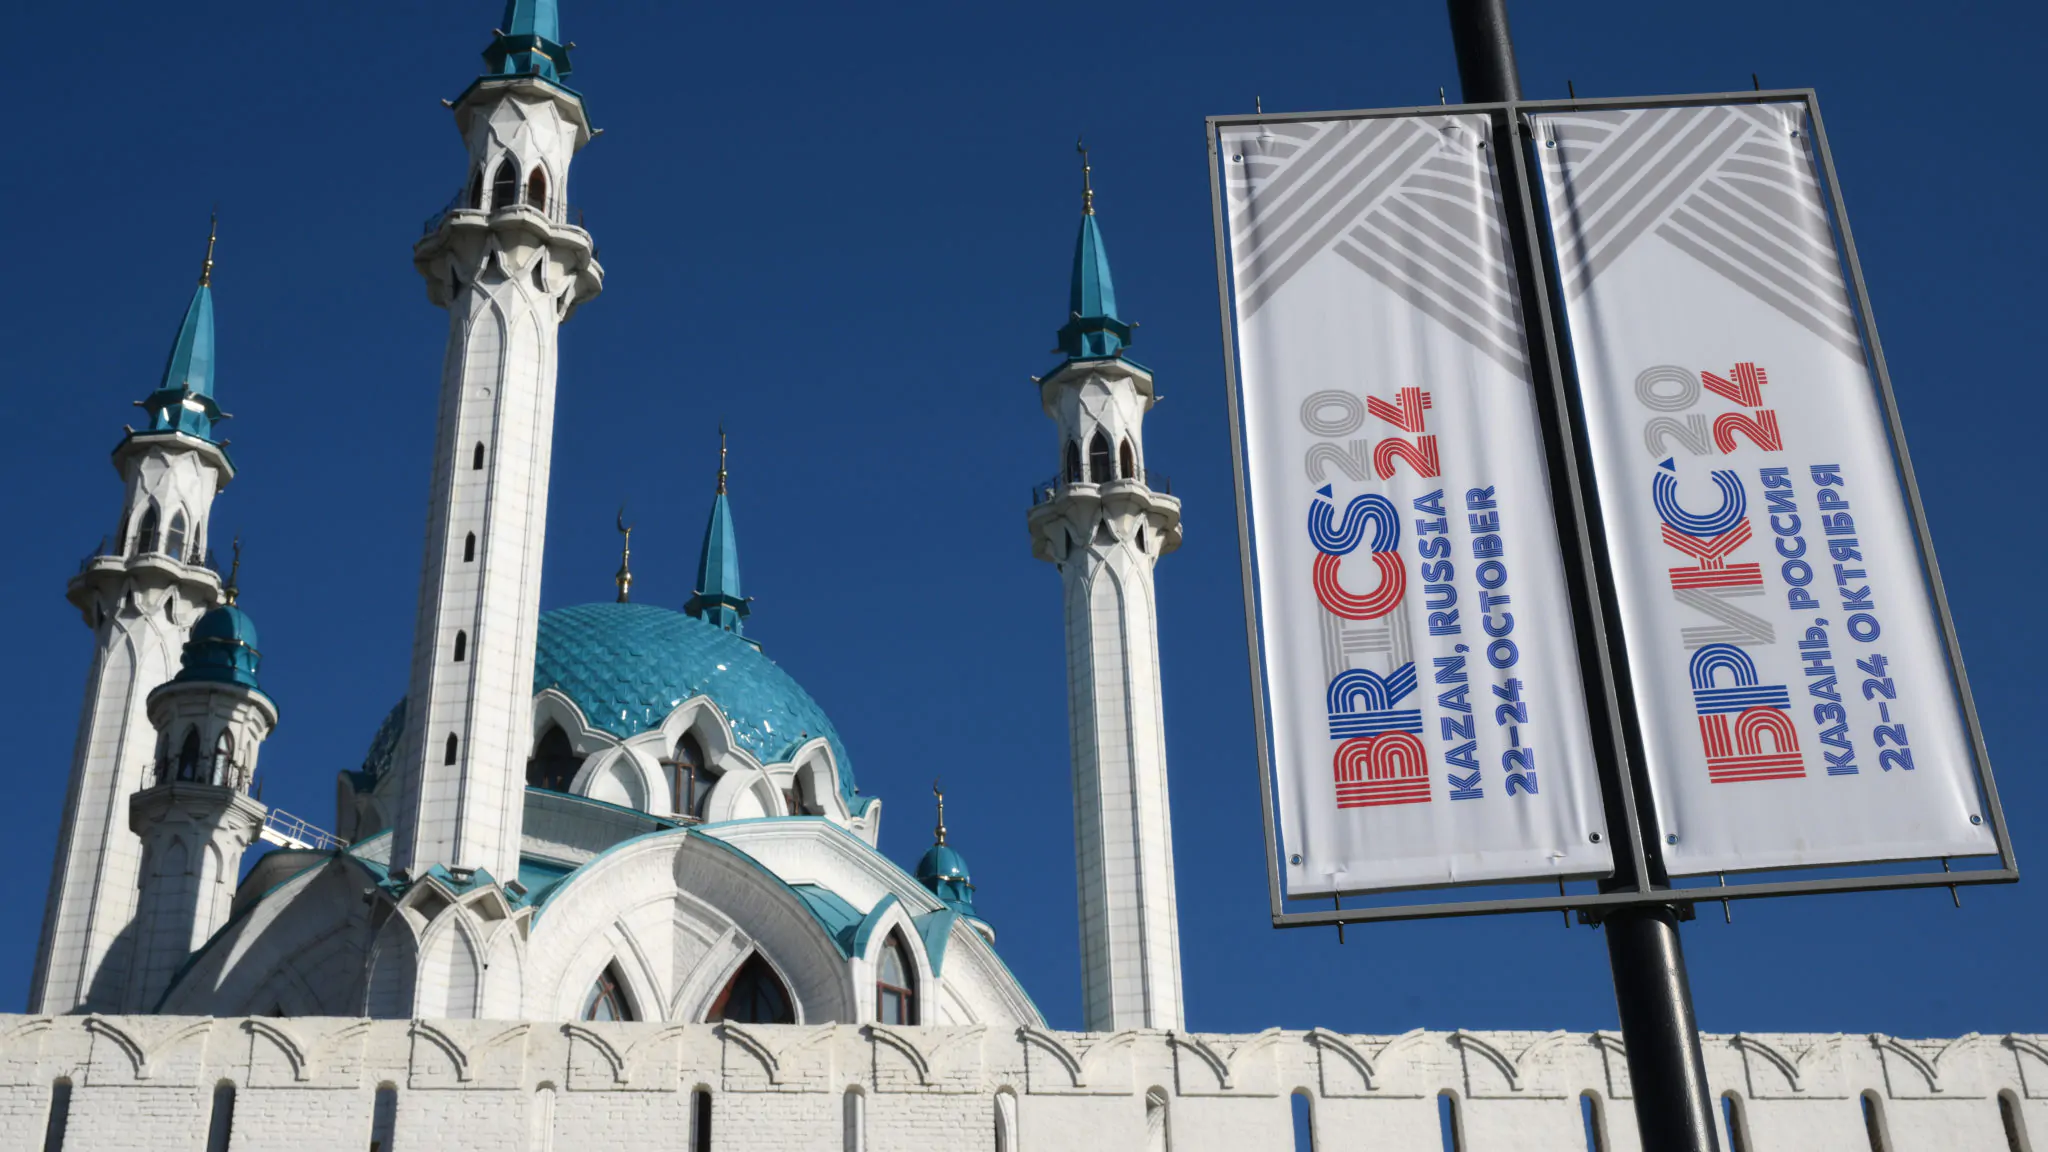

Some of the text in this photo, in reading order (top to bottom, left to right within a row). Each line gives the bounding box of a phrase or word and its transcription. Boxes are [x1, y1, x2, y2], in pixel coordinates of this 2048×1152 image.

[1300, 389, 1371, 485] 20
[1366, 386, 1441, 481] 24
[1634, 364, 1712, 458] 20
[1700, 362, 1783, 455] 24
[1465, 485, 1519, 669] OCTOBER
[1652, 469, 1806, 784] БРИКС
[1759, 466, 1859, 776] КАЗАНЬ, РОССИЯ
[1809, 463, 1881, 643] ОКТЯБРЯ
[1308, 493, 1432, 809] BRICS
[1412, 488, 1484, 801] KAZAN, RUSSIA
